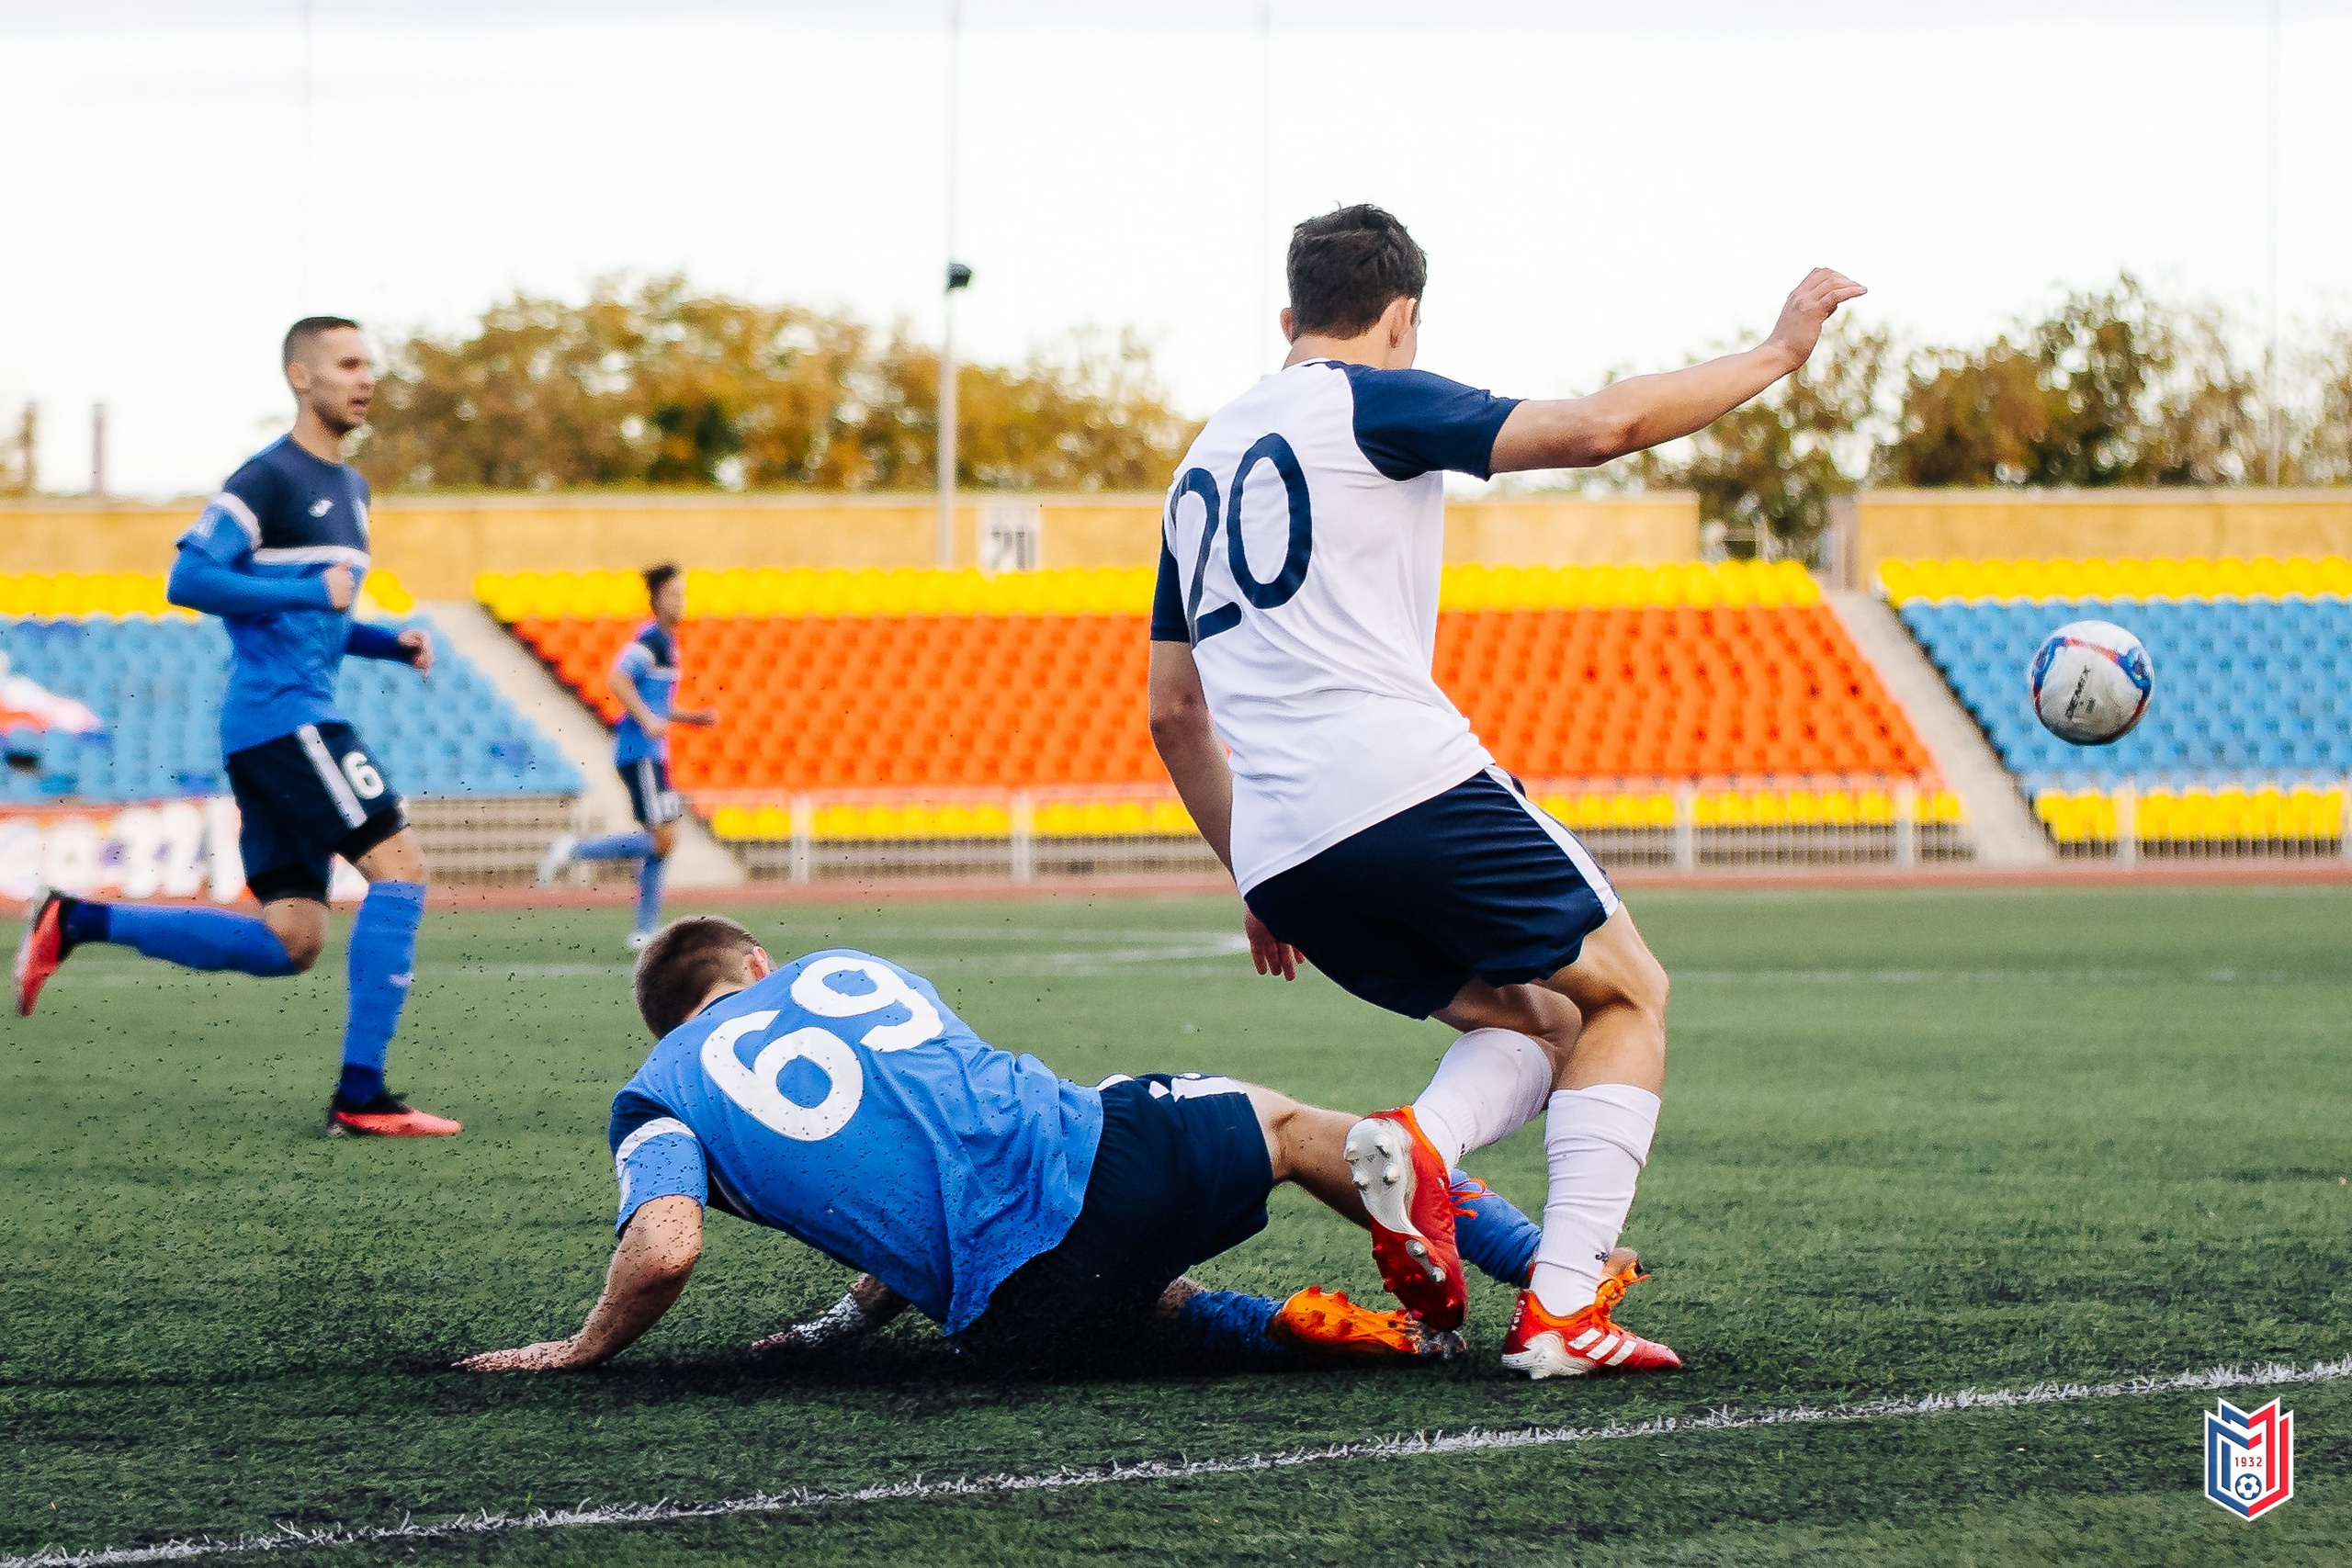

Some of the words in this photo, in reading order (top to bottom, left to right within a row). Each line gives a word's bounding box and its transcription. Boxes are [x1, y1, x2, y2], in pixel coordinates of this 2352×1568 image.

[1170, 432, 1312, 649] 20
[342, 751, 385, 799] 6
[701, 956, 944, 1142] 69
